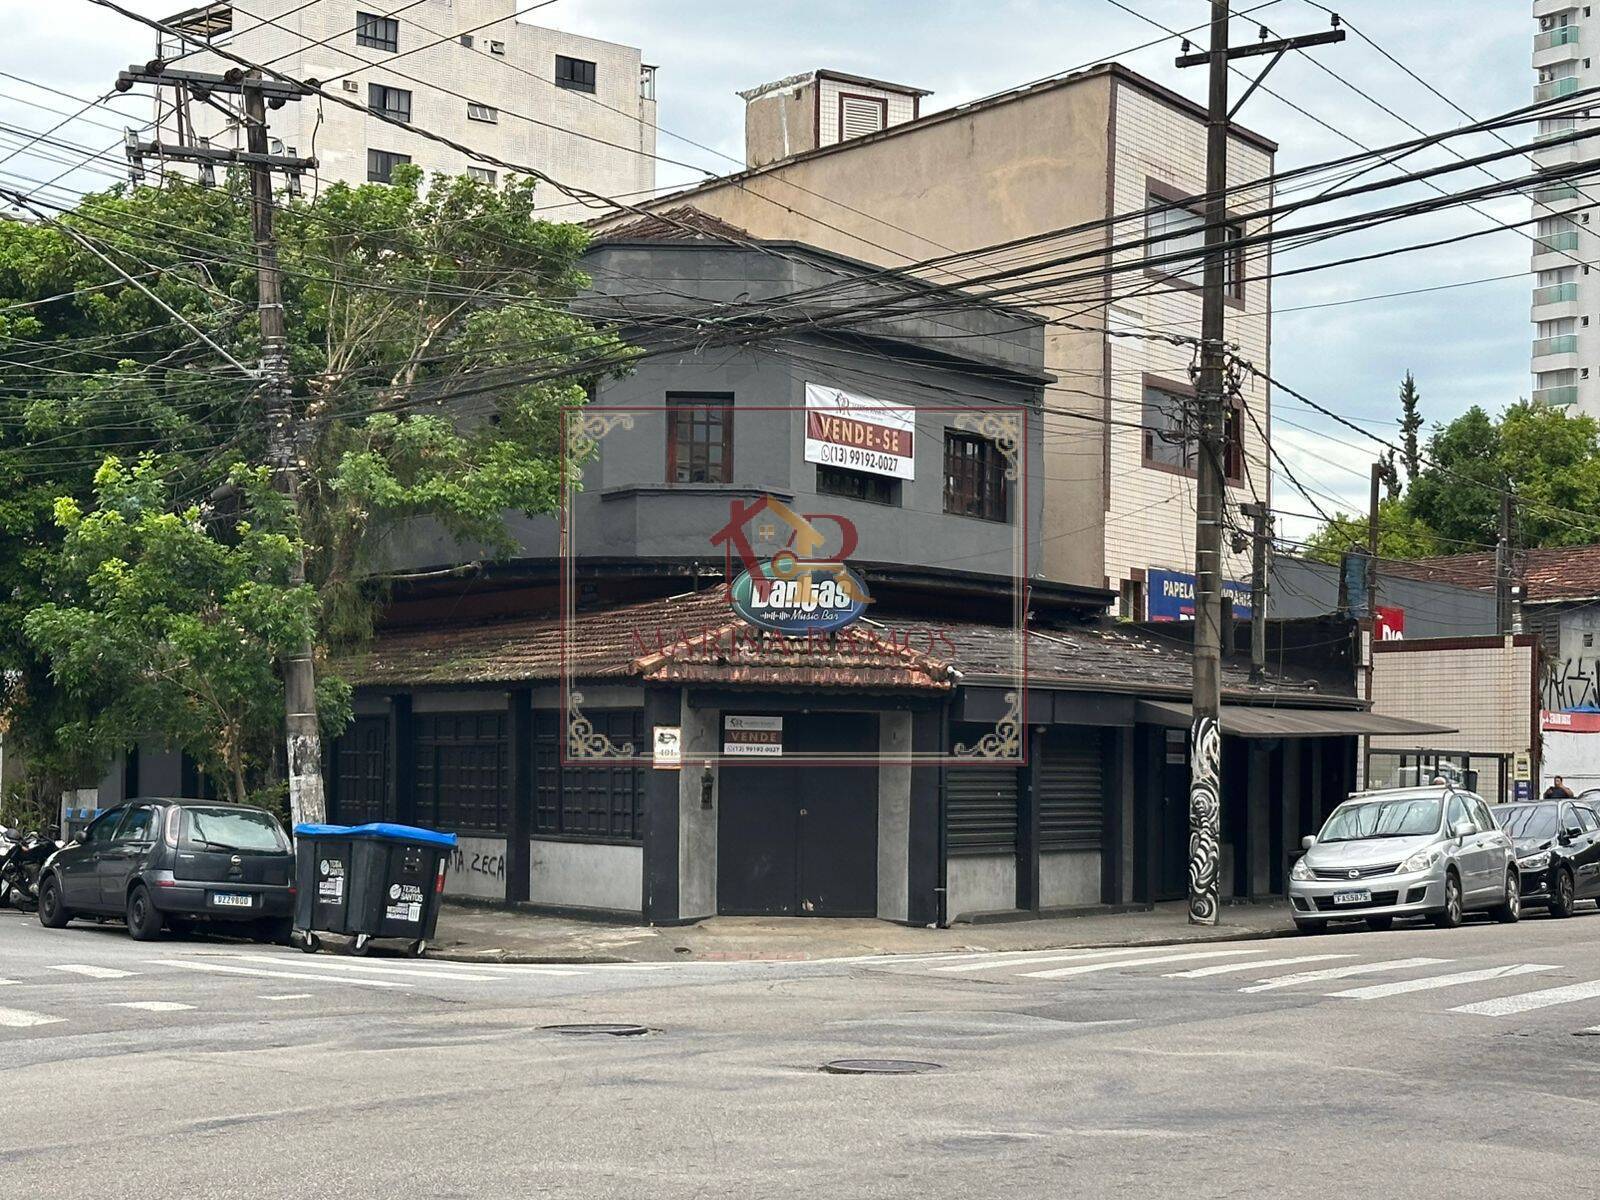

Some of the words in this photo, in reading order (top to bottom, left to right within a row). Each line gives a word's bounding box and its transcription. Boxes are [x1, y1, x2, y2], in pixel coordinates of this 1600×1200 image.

[820, 415, 899, 452] VENDE-SE
[830, 445, 848, 465] (13)
[849, 449, 898, 472] 99192-0027
[1163, 580, 1195, 600] PAPELA
[790, 609, 820, 621] Music
[820, 609, 839, 621] Bar
[731, 732, 777, 743] VENDE
[471, 854, 504, 880] ZECA
[400, 893, 423, 903] SANTOS
